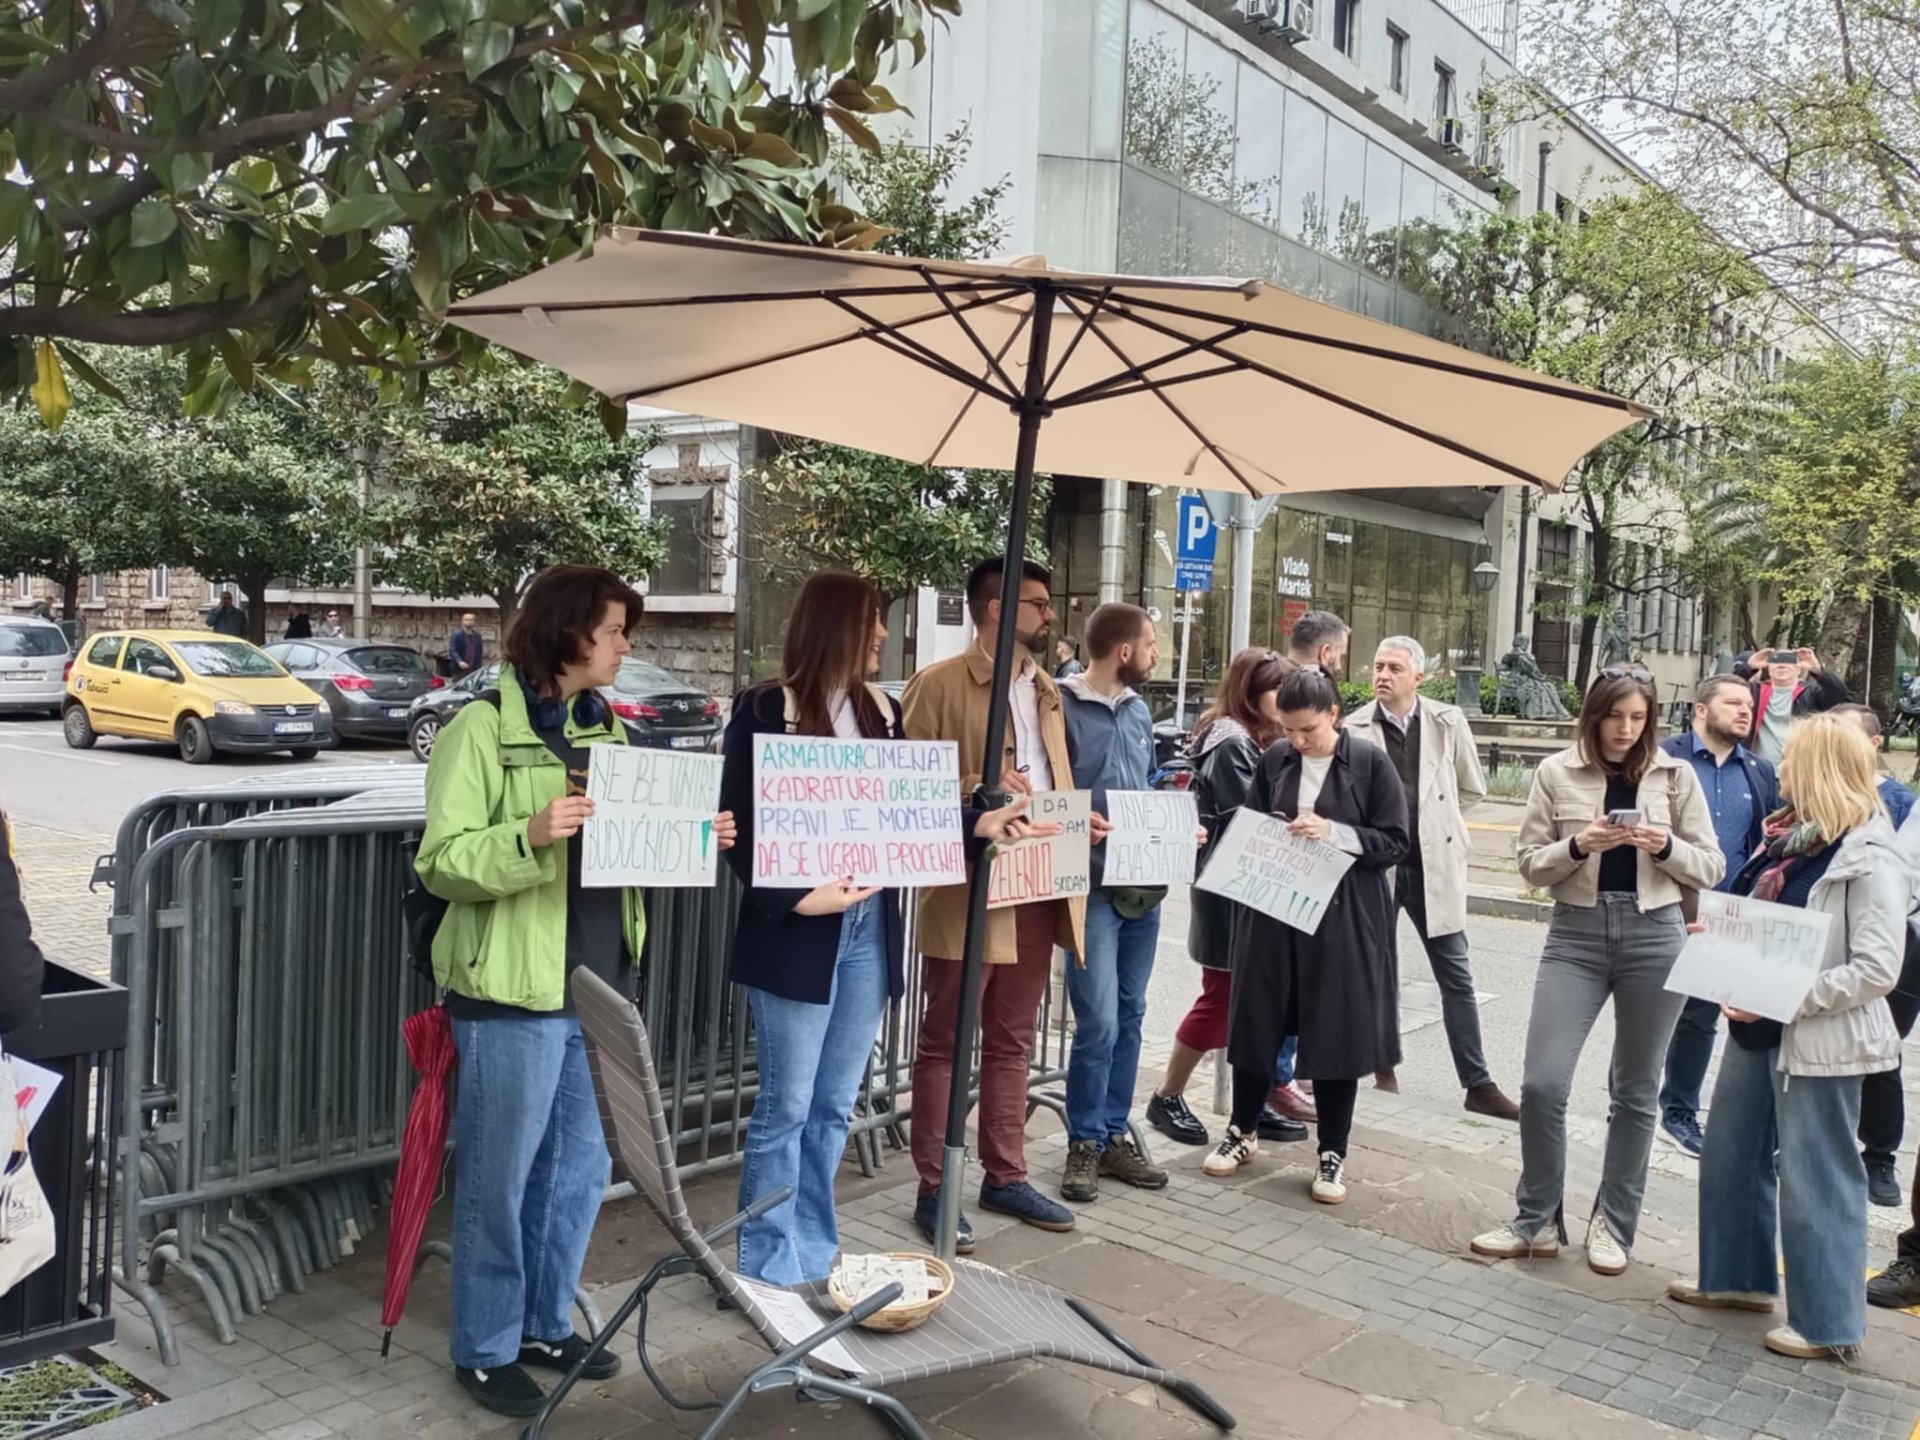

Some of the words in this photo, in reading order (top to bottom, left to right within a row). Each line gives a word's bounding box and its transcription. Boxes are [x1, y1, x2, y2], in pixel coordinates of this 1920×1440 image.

[1188, 505, 1211, 551] P
[1282, 556, 1309, 577] Vlado
[1278, 576, 1312, 598] Martek
[591, 749, 627, 803] NE
[888, 778, 960, 801] OBJEKAT
[1043, 798, 1068, 813] DA
[759, 807, 828, 836] PRAVI
[840, 807, 869, 832] JE
[878, 807, 962, 832] MOMENAT
[758, 842, 781, 878] DA
[788, 842, 811, 876] SE
[818, 843, 880, 879] UGRADI
[886, 842, 966, 876] PROCENAT
